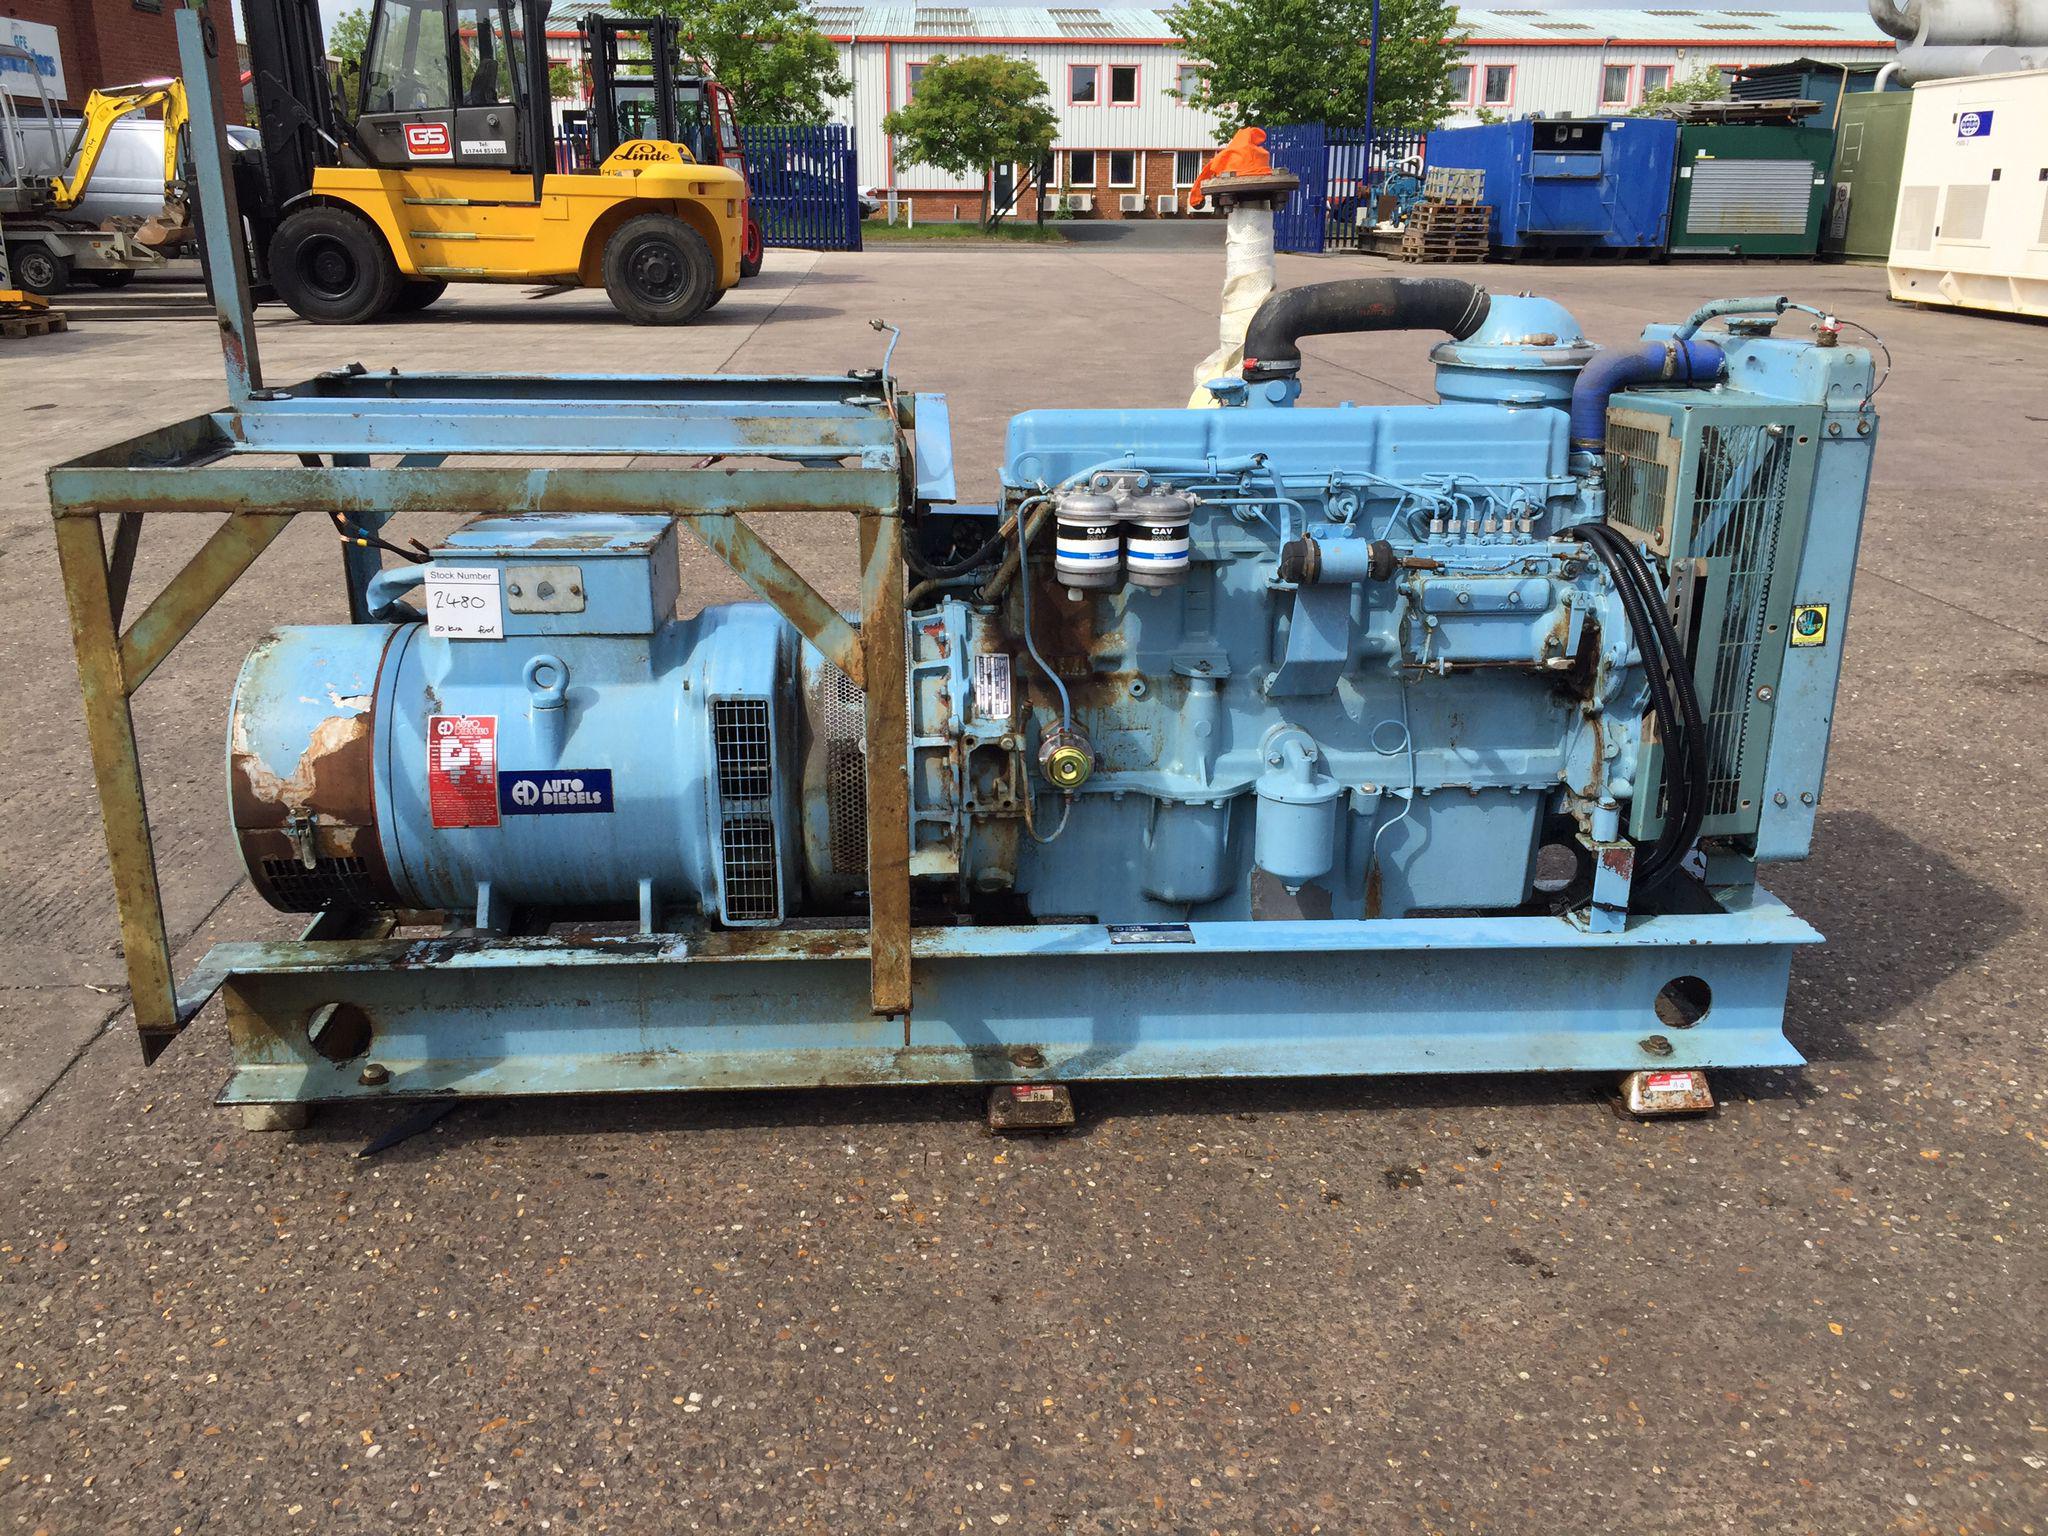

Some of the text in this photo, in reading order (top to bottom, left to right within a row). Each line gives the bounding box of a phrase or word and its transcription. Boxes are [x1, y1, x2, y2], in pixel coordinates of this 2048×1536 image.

[409, 128, 446, 145] GS
[613, 142, 674, 161] Linde
[1086, 527, 1108, 535] CAV
[1151, 527, 1173, 535] CAV
[430, 571, 491, 580] Stock Number
[433, 590, 486, 609] 2480
[541, 778, 585, 793] AUTO
[542, 791, 602, 805] DIESELS
